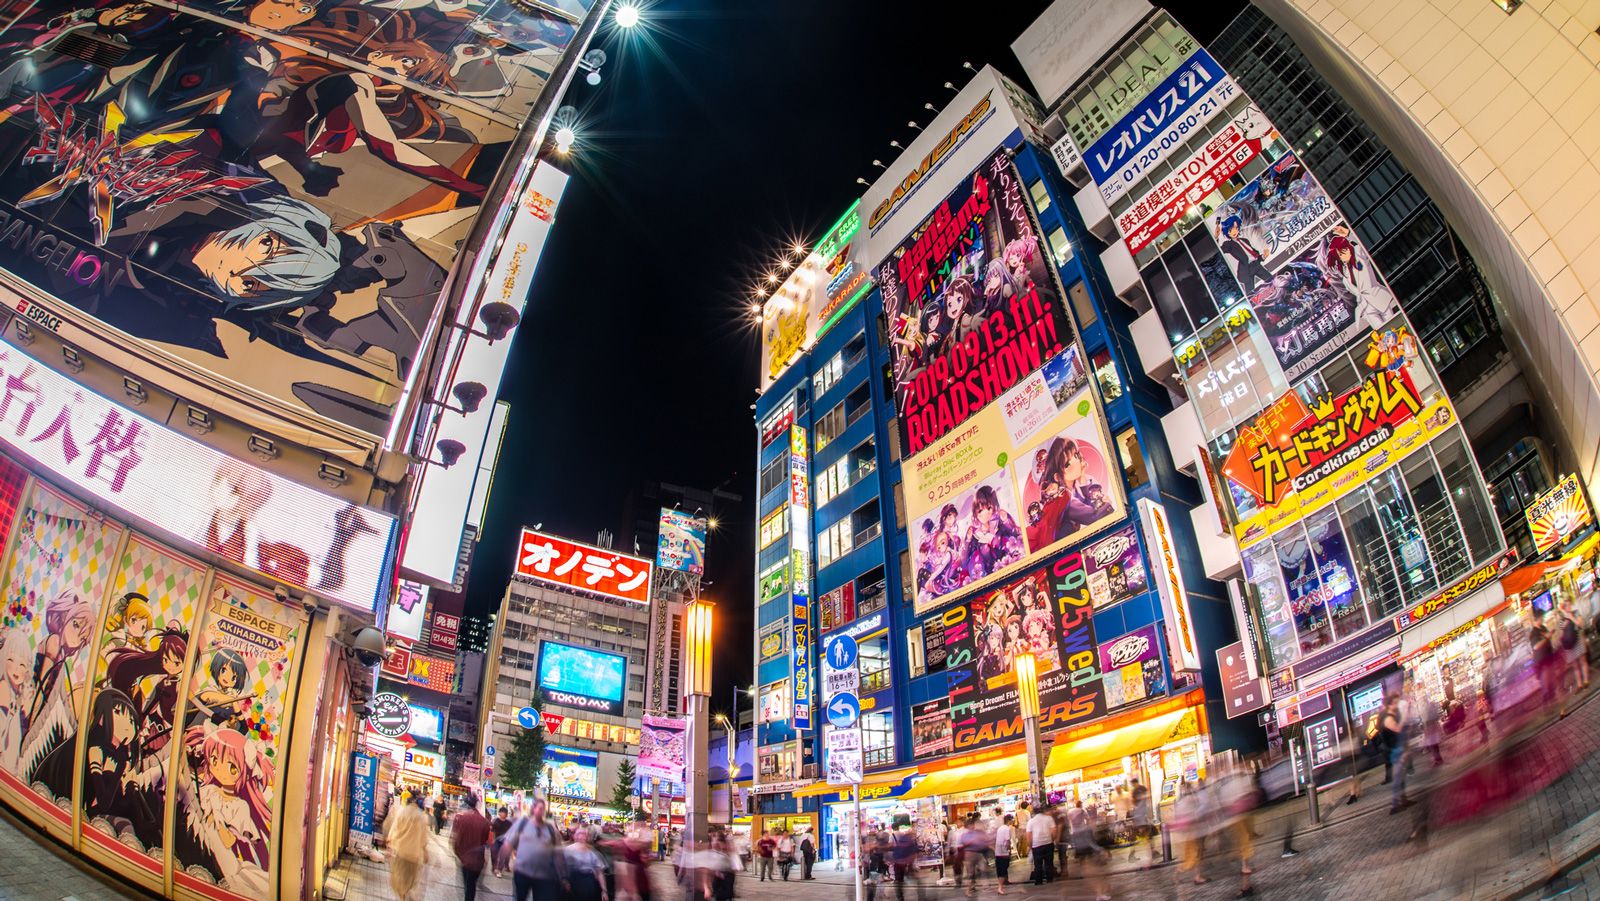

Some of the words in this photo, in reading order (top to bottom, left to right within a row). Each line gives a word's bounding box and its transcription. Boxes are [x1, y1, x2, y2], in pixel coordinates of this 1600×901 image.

[1179, 40, 1194, 56] 8F
[1103, 54, 1170, 111] iDEAL
[1219, 86, 1234, 100] 7F
[1096, 60, 1212, 172] レオパレス21
[869, 88, 994, 229] GAMERS
[1236, 147, 1250, 162] 6F
[838, 212, 859, 236] FREE
[1264, 197, 1331, 254] 天馬解放
[1302, 224, 1326, 243] Stand
[918, 257, 952, 309] FILM
[949, 216, 985, 265] LIVE
[26, 304, 63, 332] ESPACE
[1308, 344, 1335, 364] Stand
[907, 312, 1063, 455] ROADSHOW!!
[1254, 369, 1421, 503] カードキングダム
[928, 482, 951, 502] 9.25
[1529, 480, 1577, 524] 真光無線
[522, 543, 647, 592] オノデン
[228, 607, 277, 633] ESPACE
[435, 615, 459, 630] 免税
[1337, 603, 1360, 619] Real
[219, 621, 278, 649] AKIHABARA
[831, 680, 854, 690] 16-19
[373, 692, 409, 715] SMOKER'S
[550, 691, 586, 706] TOKYO
[588, 699, 610, 711] MX
[545, 716, 561, 724] 止まれ
[955, 692, 1099, 748] GAMERS
[352, 775, 367, 831] 欢迎使用
